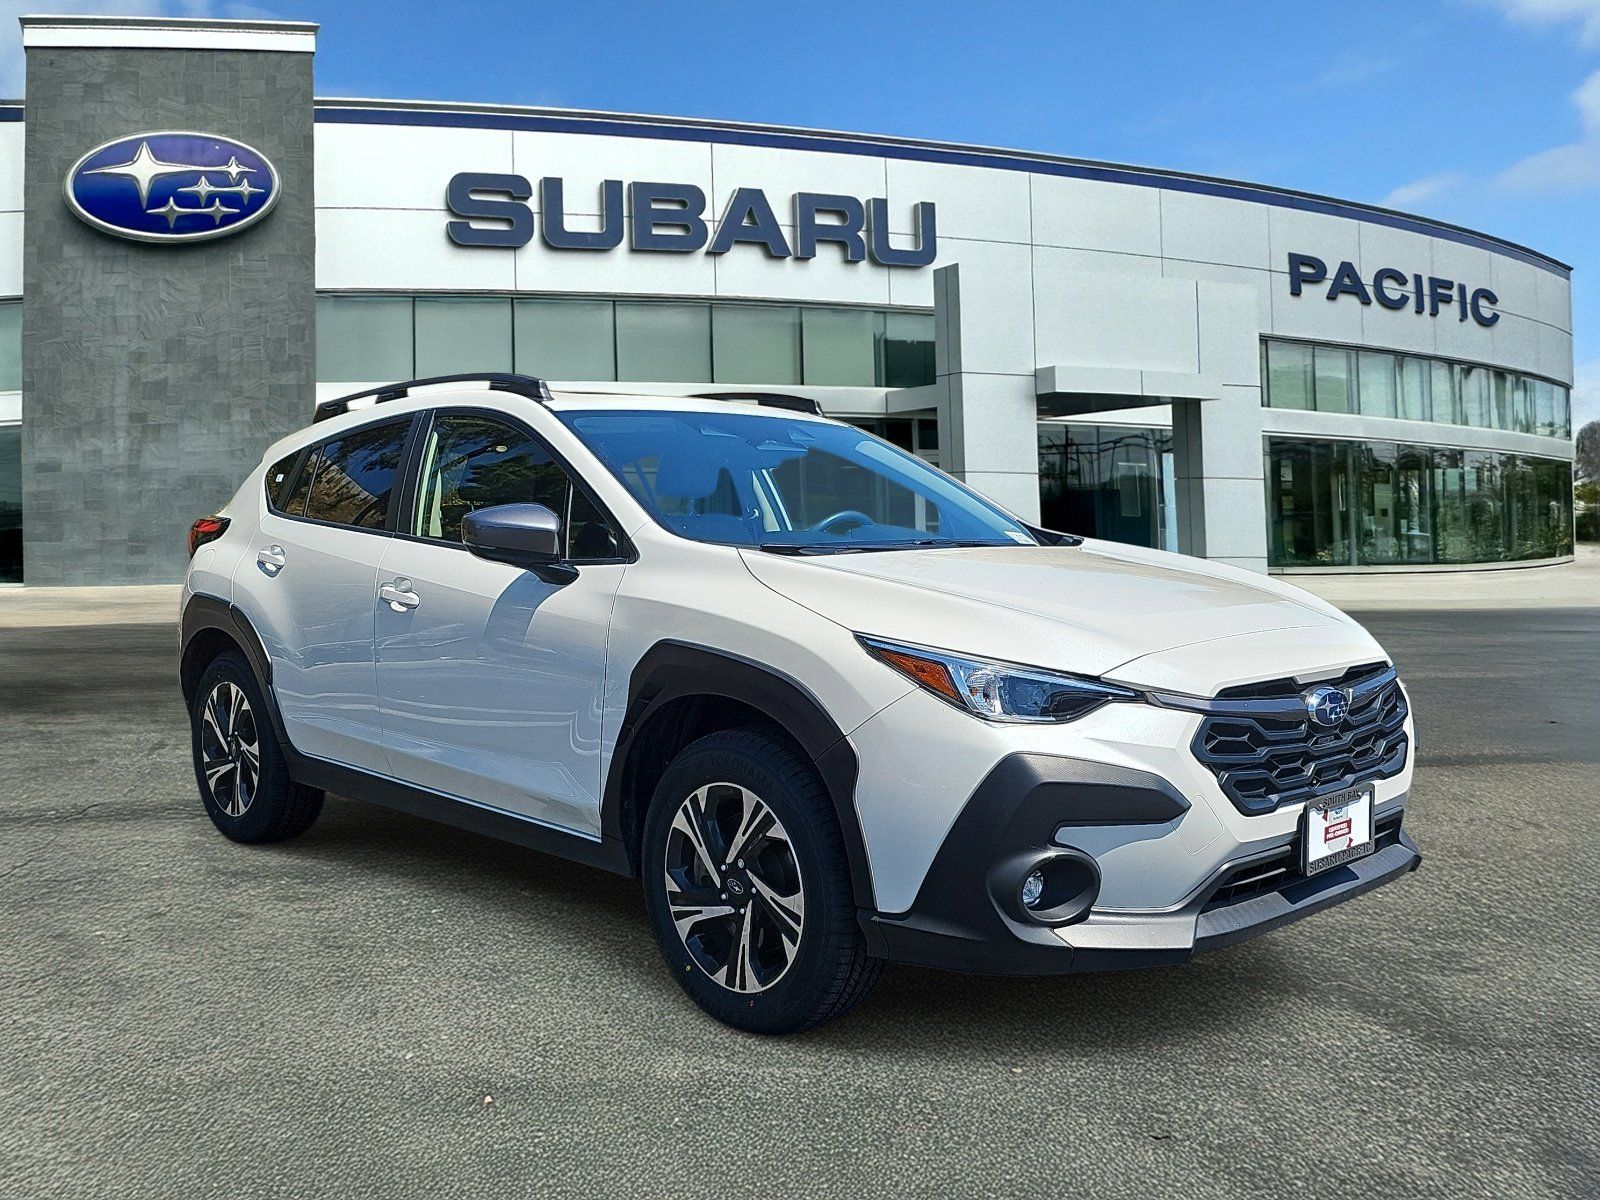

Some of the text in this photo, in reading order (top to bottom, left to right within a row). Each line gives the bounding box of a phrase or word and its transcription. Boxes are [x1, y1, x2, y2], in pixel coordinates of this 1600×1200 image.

[446, 171, 938, 268] SUBARU
[1287, 252, 1501, 328] PACIFIC
[1322, 793, 1346, 808] SOUTH
[1309, 842, 1373, 873] SUBARU PACIFIC
